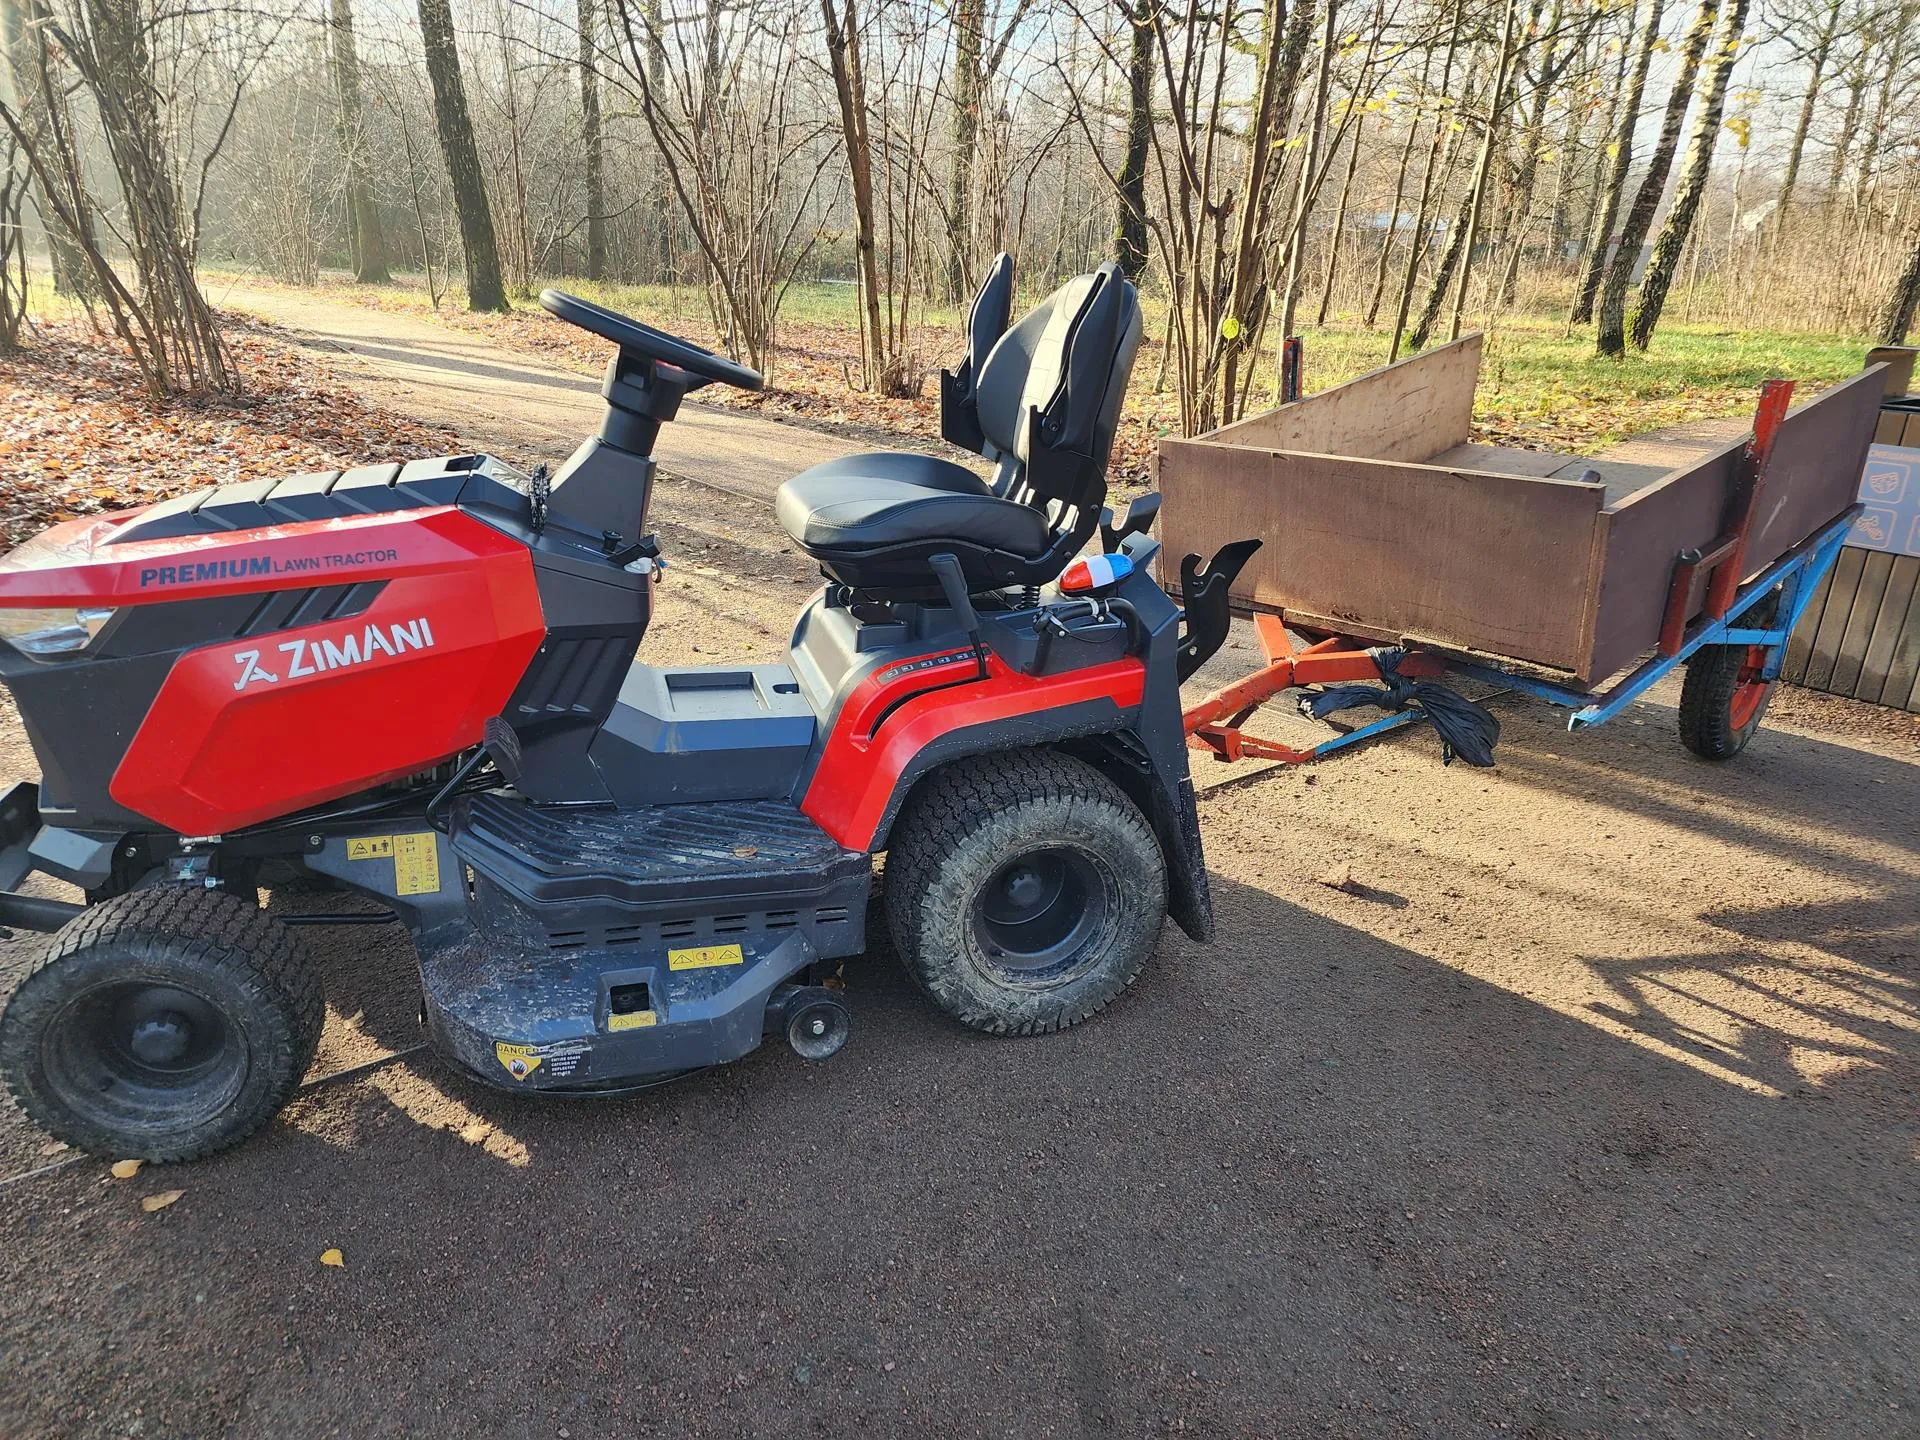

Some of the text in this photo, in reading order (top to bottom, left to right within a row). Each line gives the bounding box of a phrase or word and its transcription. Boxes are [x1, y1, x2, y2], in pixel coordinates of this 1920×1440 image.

[140, 549, 398, 587] PREMIUM LAWN TRACTOR
[278, 617, 435, 679] ZIMANI
